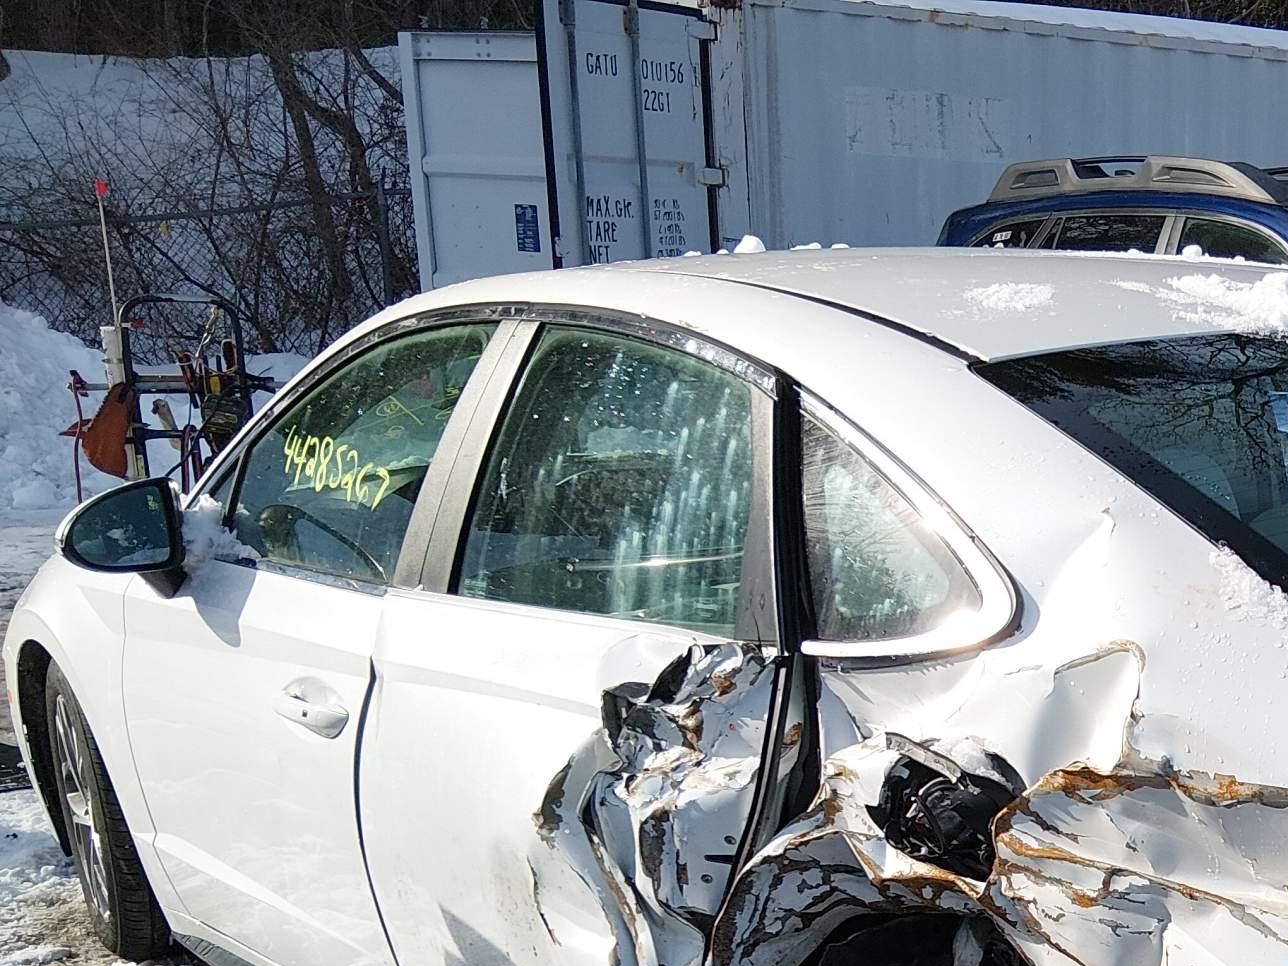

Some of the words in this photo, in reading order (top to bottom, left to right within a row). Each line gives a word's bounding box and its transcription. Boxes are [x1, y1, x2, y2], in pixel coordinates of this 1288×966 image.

[586, 52, 618, 77] GATU
[643, 89, 670, 113] 22G1
[586, 220, 618, 243] TARE
